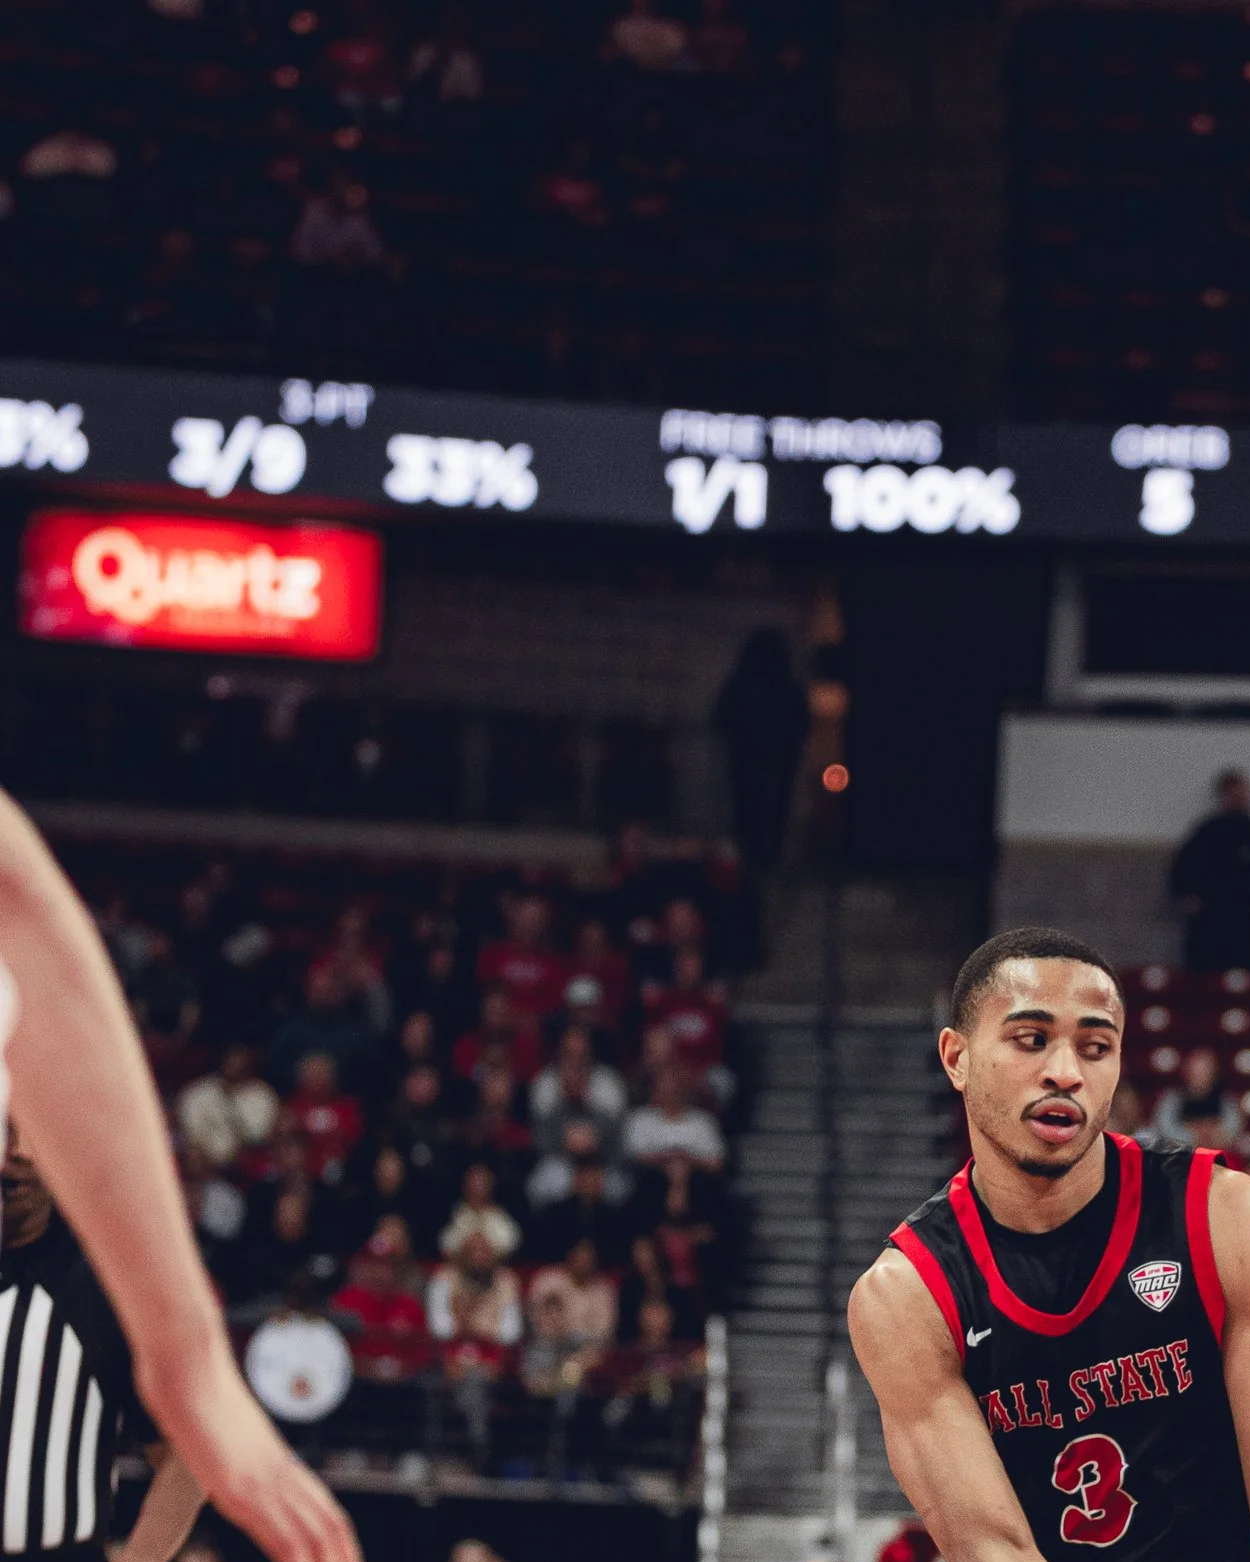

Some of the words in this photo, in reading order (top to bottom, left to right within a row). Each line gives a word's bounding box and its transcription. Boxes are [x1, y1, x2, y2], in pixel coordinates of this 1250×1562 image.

[384, 433, 539, 511] 33%
[660, 409, 768, 460] FREE
[769, 416, 943, 466] THROWS
[665, 455, 768, 535] 1/1
[823, 464, 1021, 535] 100%
[1138, 467, 1195, 536] 5
[72, 526, 322, 625] Quartz
[1133, 1275, 1179, 1294] MAC
[979, 1379, 1064, 1434] ALL
[1068, 1338, 1193, 1422] STATE
[1051, 1433, 1138, 1548] 3
